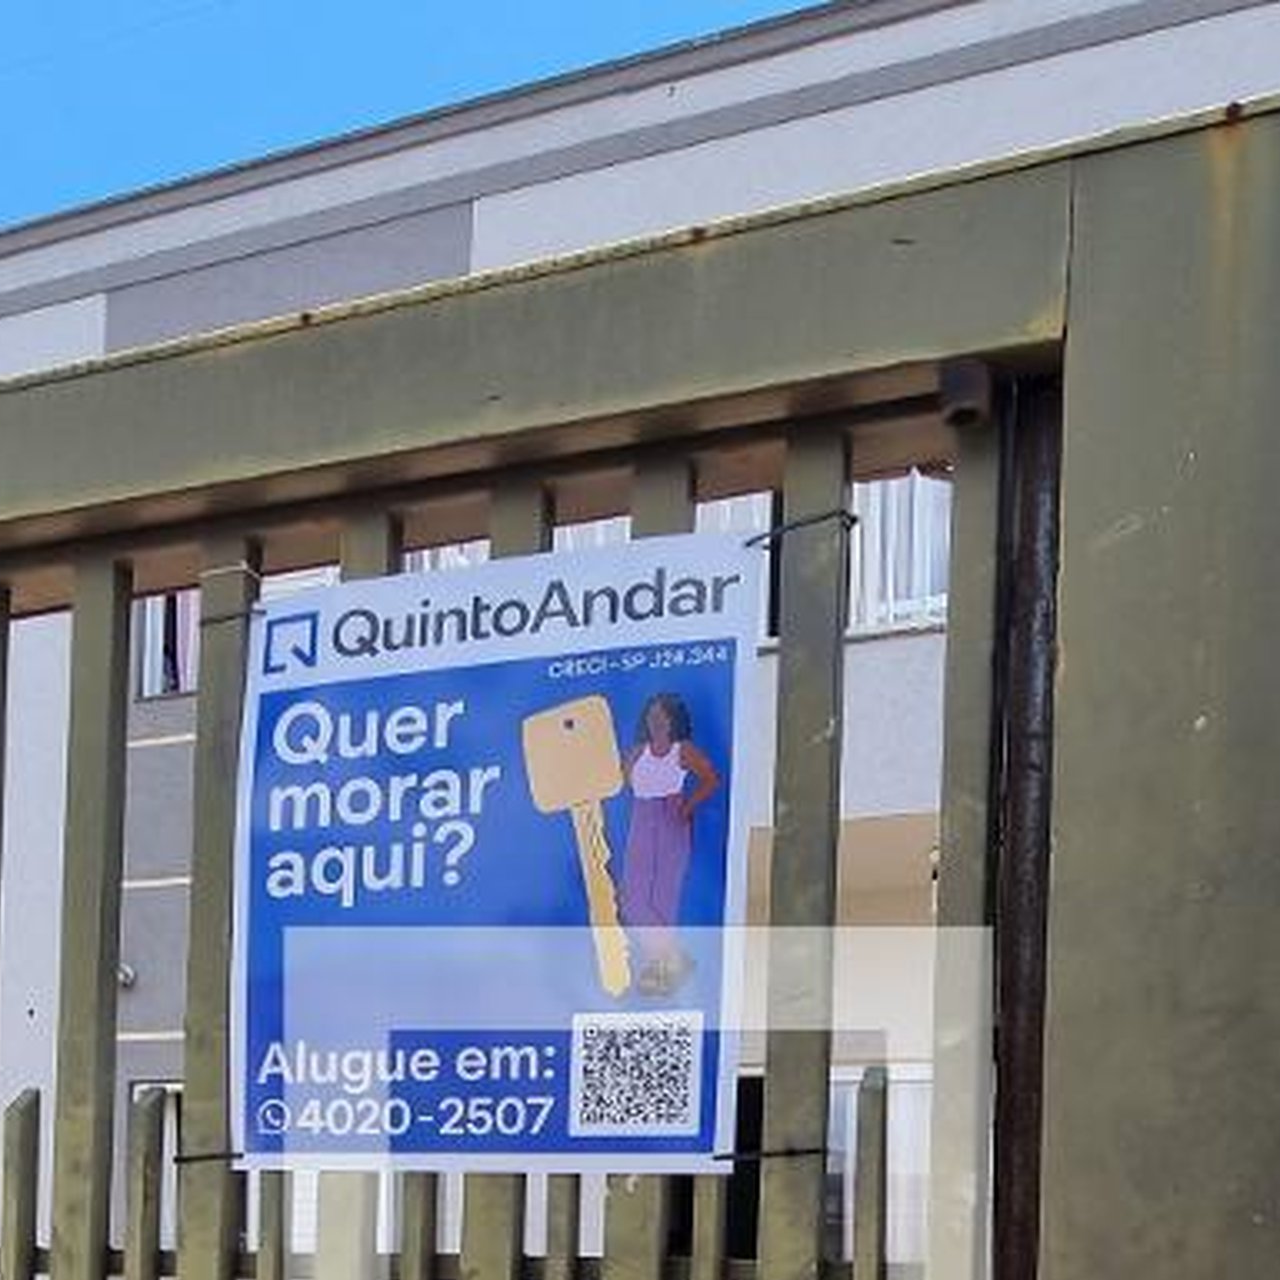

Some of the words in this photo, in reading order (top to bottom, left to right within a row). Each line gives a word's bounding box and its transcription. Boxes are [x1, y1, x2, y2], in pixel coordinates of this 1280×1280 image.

[331, 566, 741, 658] QuintoAndar
[271, 699, 466, 765] Quer
[268, 763, 502, 832] morar
[265, 822, 476, 906] aqui?
[257, 1041, 441, 1095] Alugue
[455, 1043, 557, 1080] em:
[297, 1096, 555, 1136] 4020-2507
